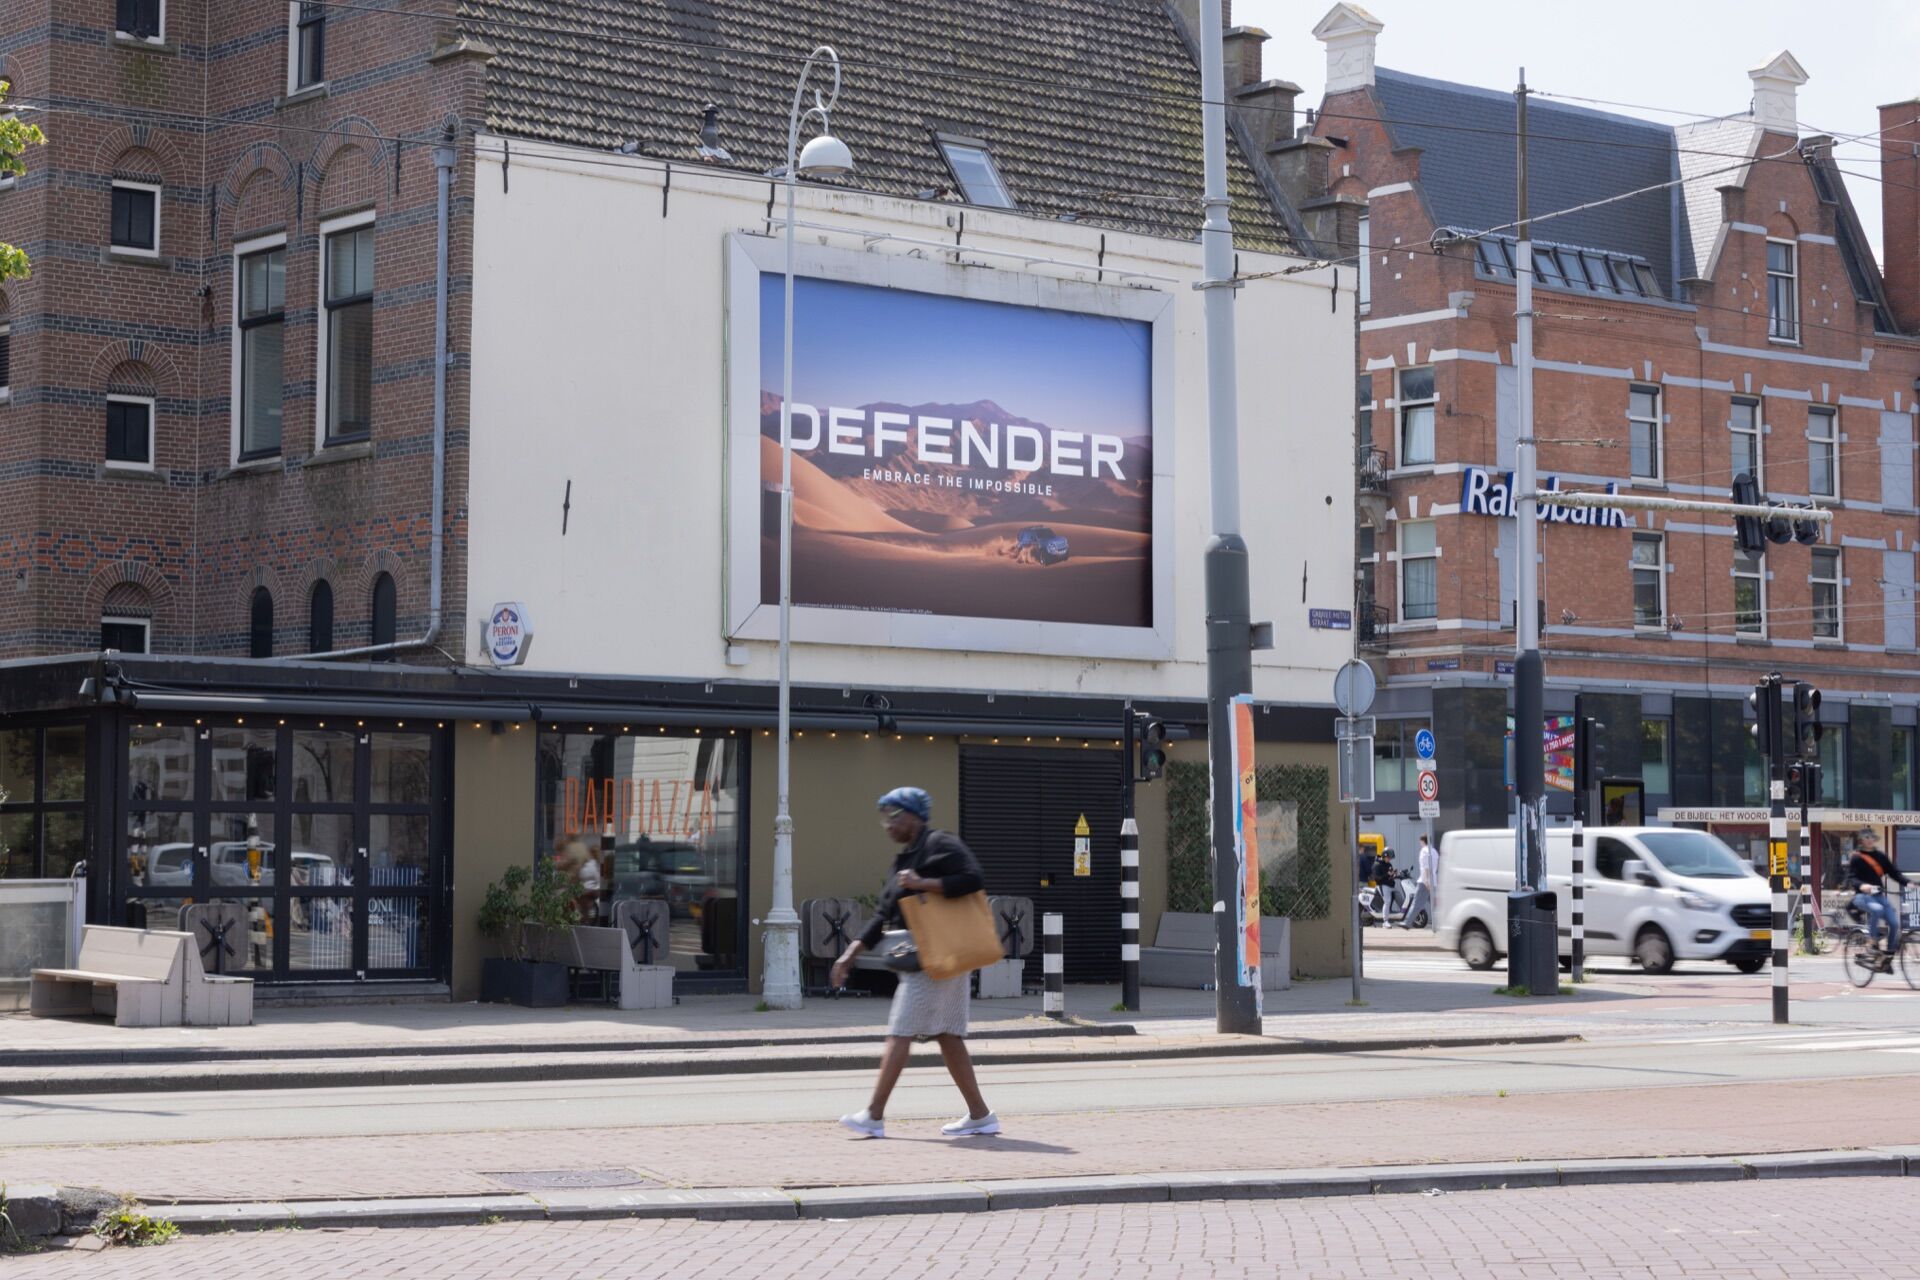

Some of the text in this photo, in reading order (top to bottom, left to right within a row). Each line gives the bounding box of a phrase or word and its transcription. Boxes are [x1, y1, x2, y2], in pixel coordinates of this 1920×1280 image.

[780, 401, 1126, 480] DEFENDER
[863, 468, 1053, 496] EMBRACE THE IMPOSSIBLE
[493, 625, 518, 637] PERONI
[1423, 780, 1434, 791] 30
[1674, 812, 1801, 821] DE BIJBEL: HET WOORD GO
[1842, 813, 1853, 821] THE
[1875, 813, 1884, 822] THE
[1885, 814, 1904, 823] WORD
[1905, 814, 1913, 823] OF
